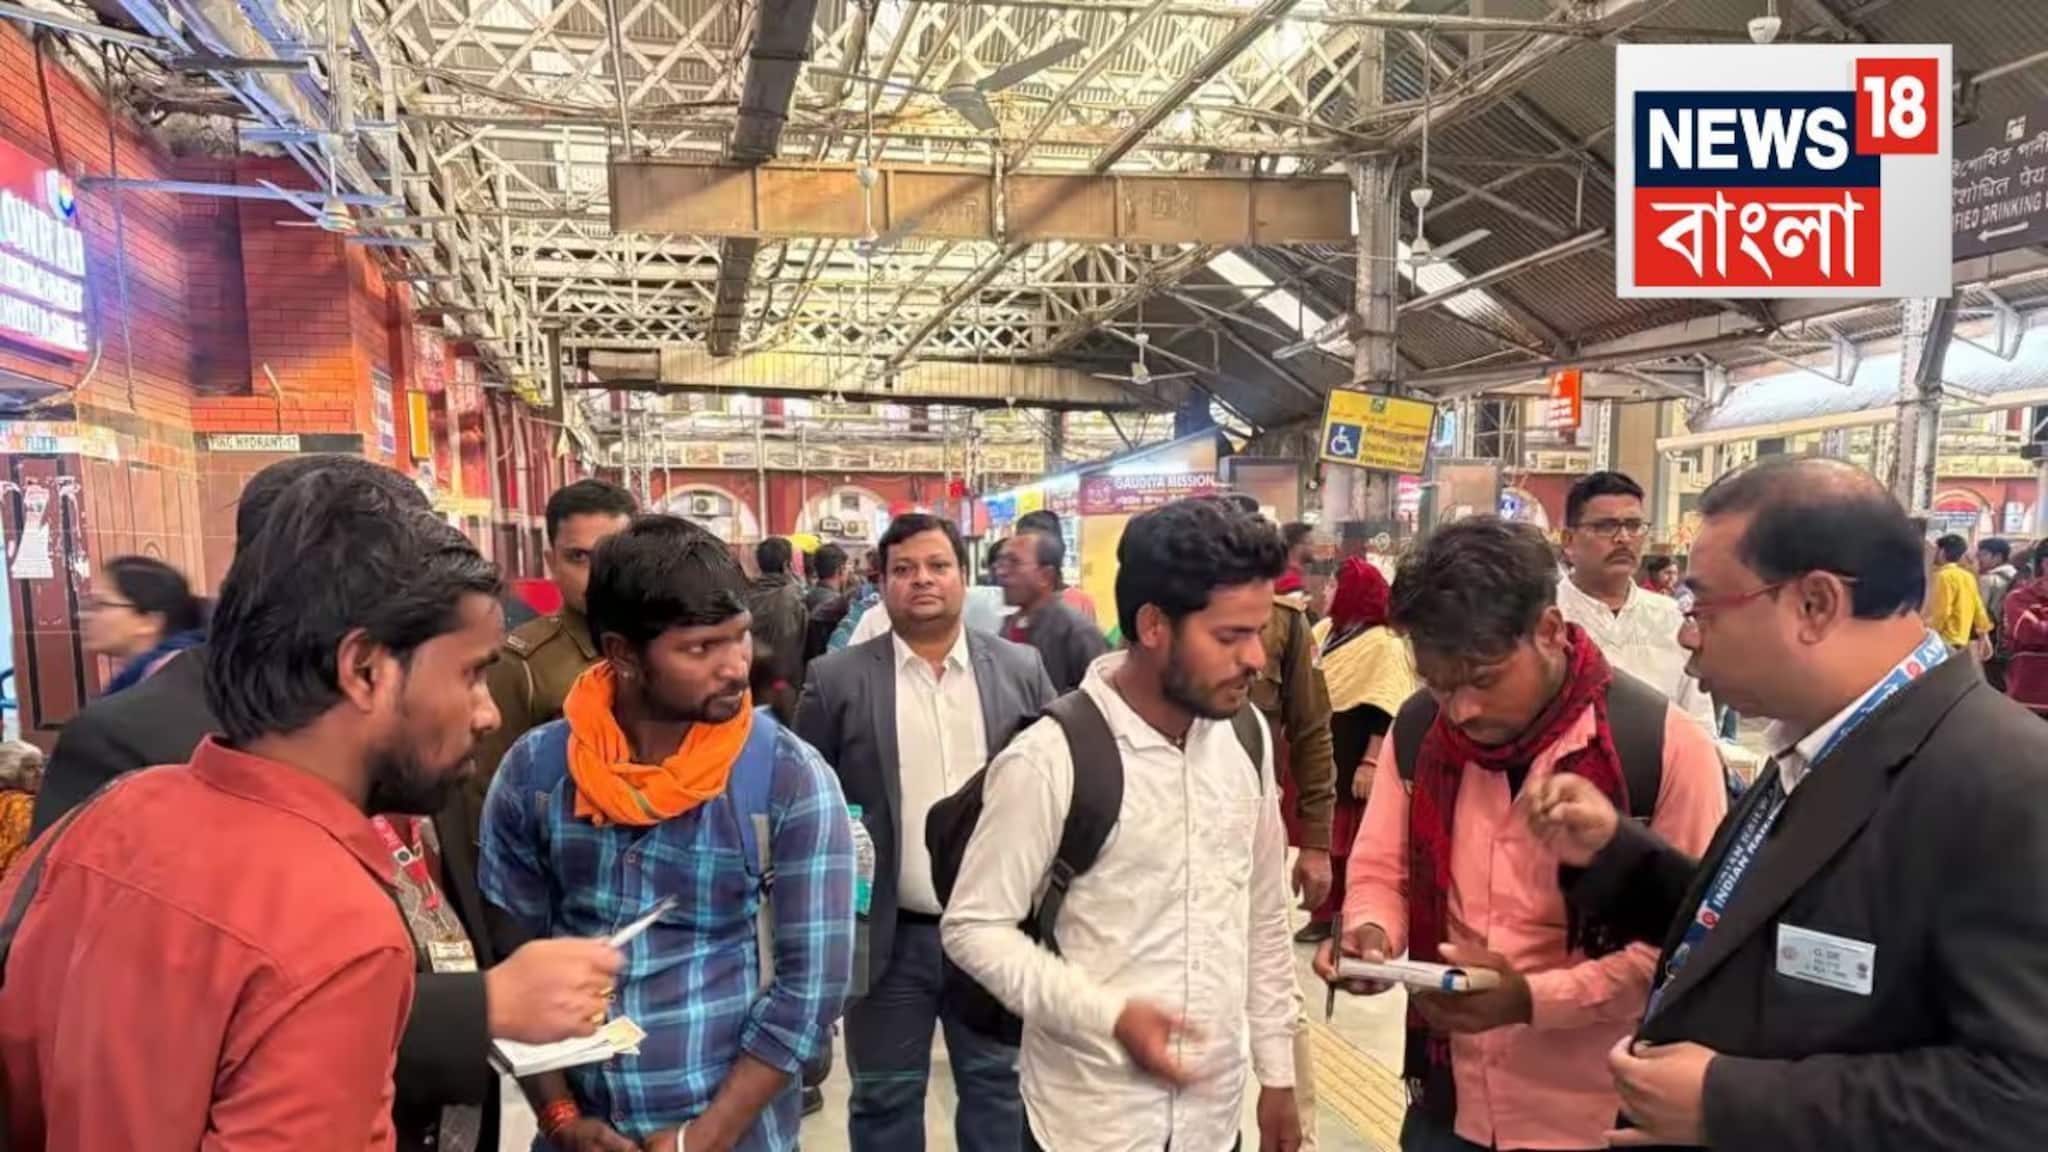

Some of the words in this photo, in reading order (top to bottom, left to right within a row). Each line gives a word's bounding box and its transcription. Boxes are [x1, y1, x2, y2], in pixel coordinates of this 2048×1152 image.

[1981, 191, 2042, 225] DRINKING
[1167, 473, 1217, 488] MISSION
[1711, 854, 1750, 908] INDIAN
